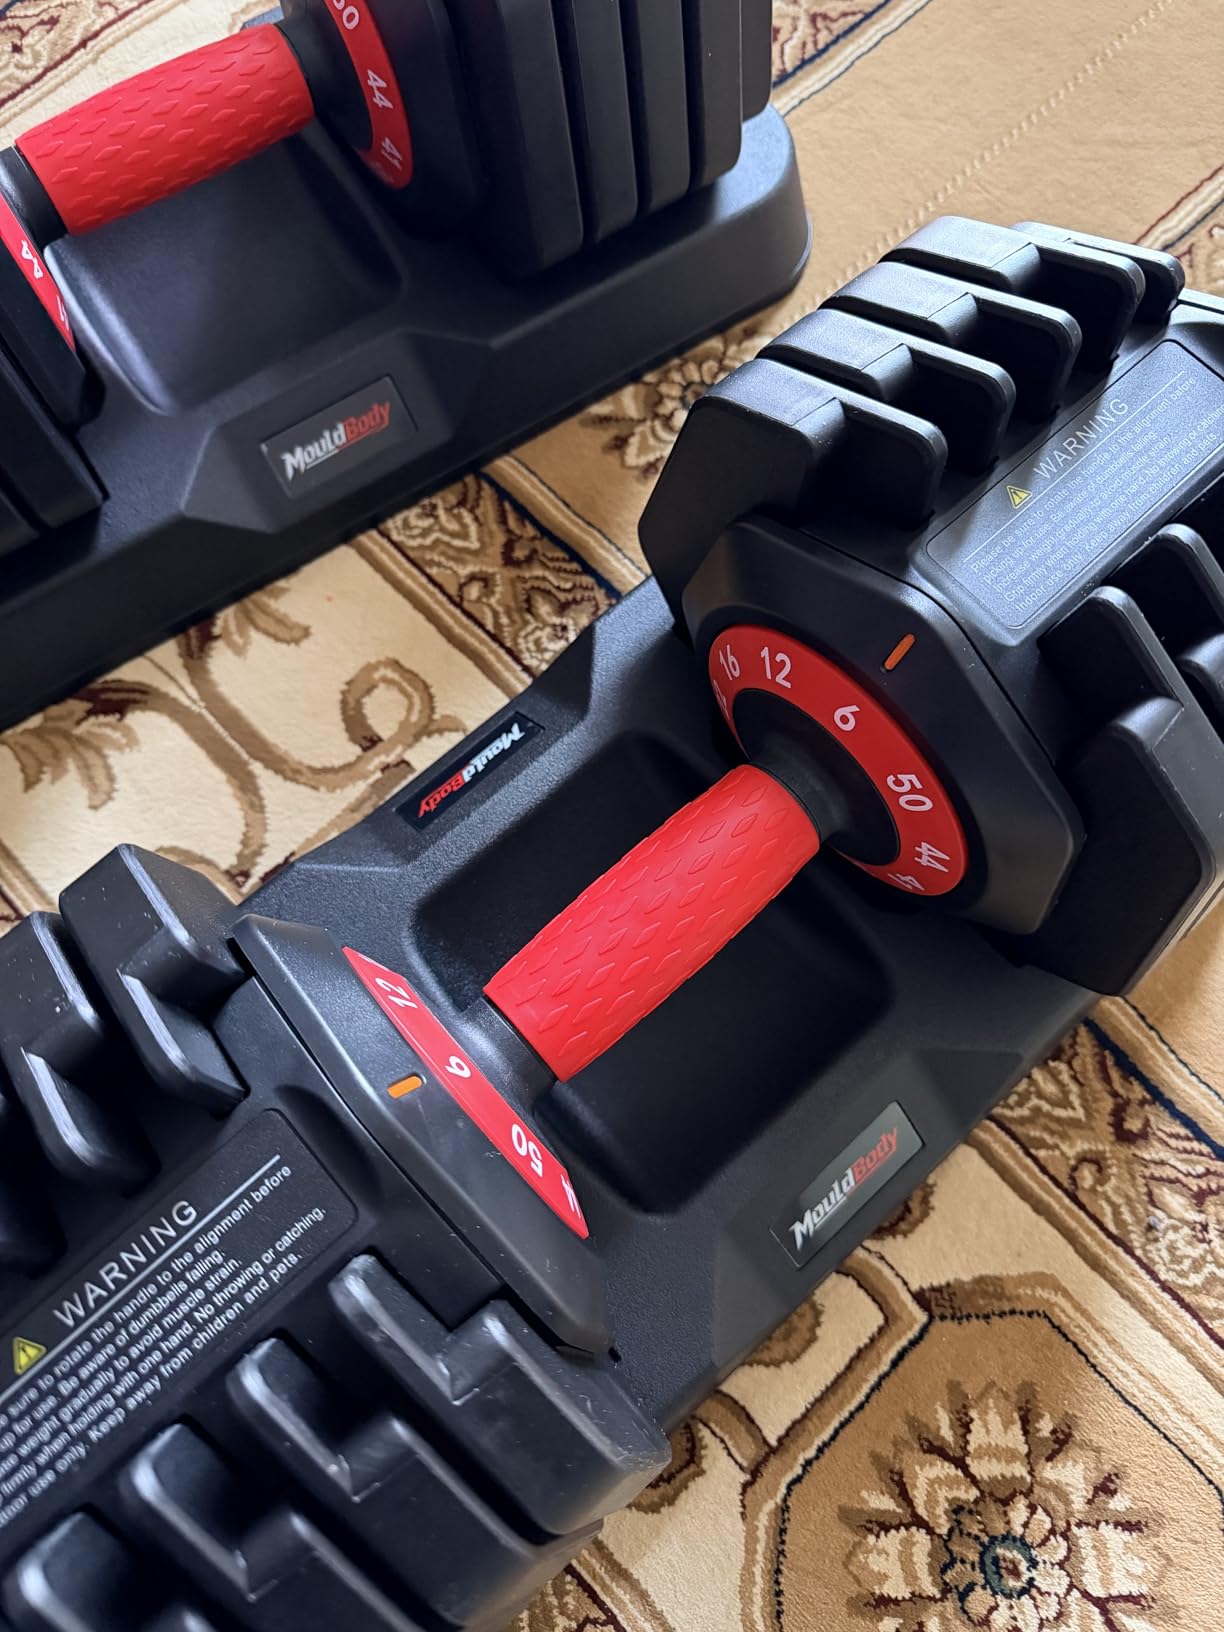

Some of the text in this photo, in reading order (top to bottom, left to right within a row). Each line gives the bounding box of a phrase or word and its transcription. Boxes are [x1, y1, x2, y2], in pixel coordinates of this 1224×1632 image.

[367, 69, 393, 109] 44
[281, 401, 391, 481] MouldBody
[1032, 398, 1128, 481] WARNING
[719, 644, 741, 681] 16
[760, 646, 792, 689] 12
[833, 704, 860, 731] 6
[418, 723, 526, 818] MouldBody
[886, 773, 934, 812] 50
[914, 841, 951, 873] 44
[511, 1123, 543, 1178] 50
[788, 1126, 898, 1251] MouldBody
[5, 1385, 40, 1417] sure
[35, 1372, 55, 1390] to
[51, 1338, 93, 1377] rotate
[89, 1319, 116, 1343] the
[111, 1281, 159, 1324] handle
[154, 1268, 174, 1286] to
[169, 1250, 195, 1273] the
[192, 1197, 253, 1254] alignment
[249, 1165, 292, 1203] before
[52, 1200, 198, 1328] WARNING
[9, 1414, 34, 1437] for
[54, 1373, 81, 1396] Be
[75, 1341, 117, 1380] aware
[112, 1326, 132, 1347] of
[125, 1278, 189, 1335] dumbbells
[183, 1248, 226, 1284] falling.
[14, 1257, 243, 1458] weight gradually to avoid muscle strain.
[32, 1430, 71, 1467] when
[65, 1391, 117, 1437] holding
[110, 1367, 140, 1397] with
[135, 1348, 164, 1375] one
[158, 1320, 197, 1354] hand.
[192, 1302, 216, 1323] No
[211, 1259, 265, 1307] throwing
[260, 1247, 277, 1265] or
[273, 1206, 326, 1253] catching.
[85, 1405, 129, 1444] Keep
[123, 1373, 165, 1411] away
[157, 1346, 193, 1378] from
[191, 1300, 245, 1350] children
[242, 1275, 270, 1304] and
[267, 1251, 302, 1284] pets.
